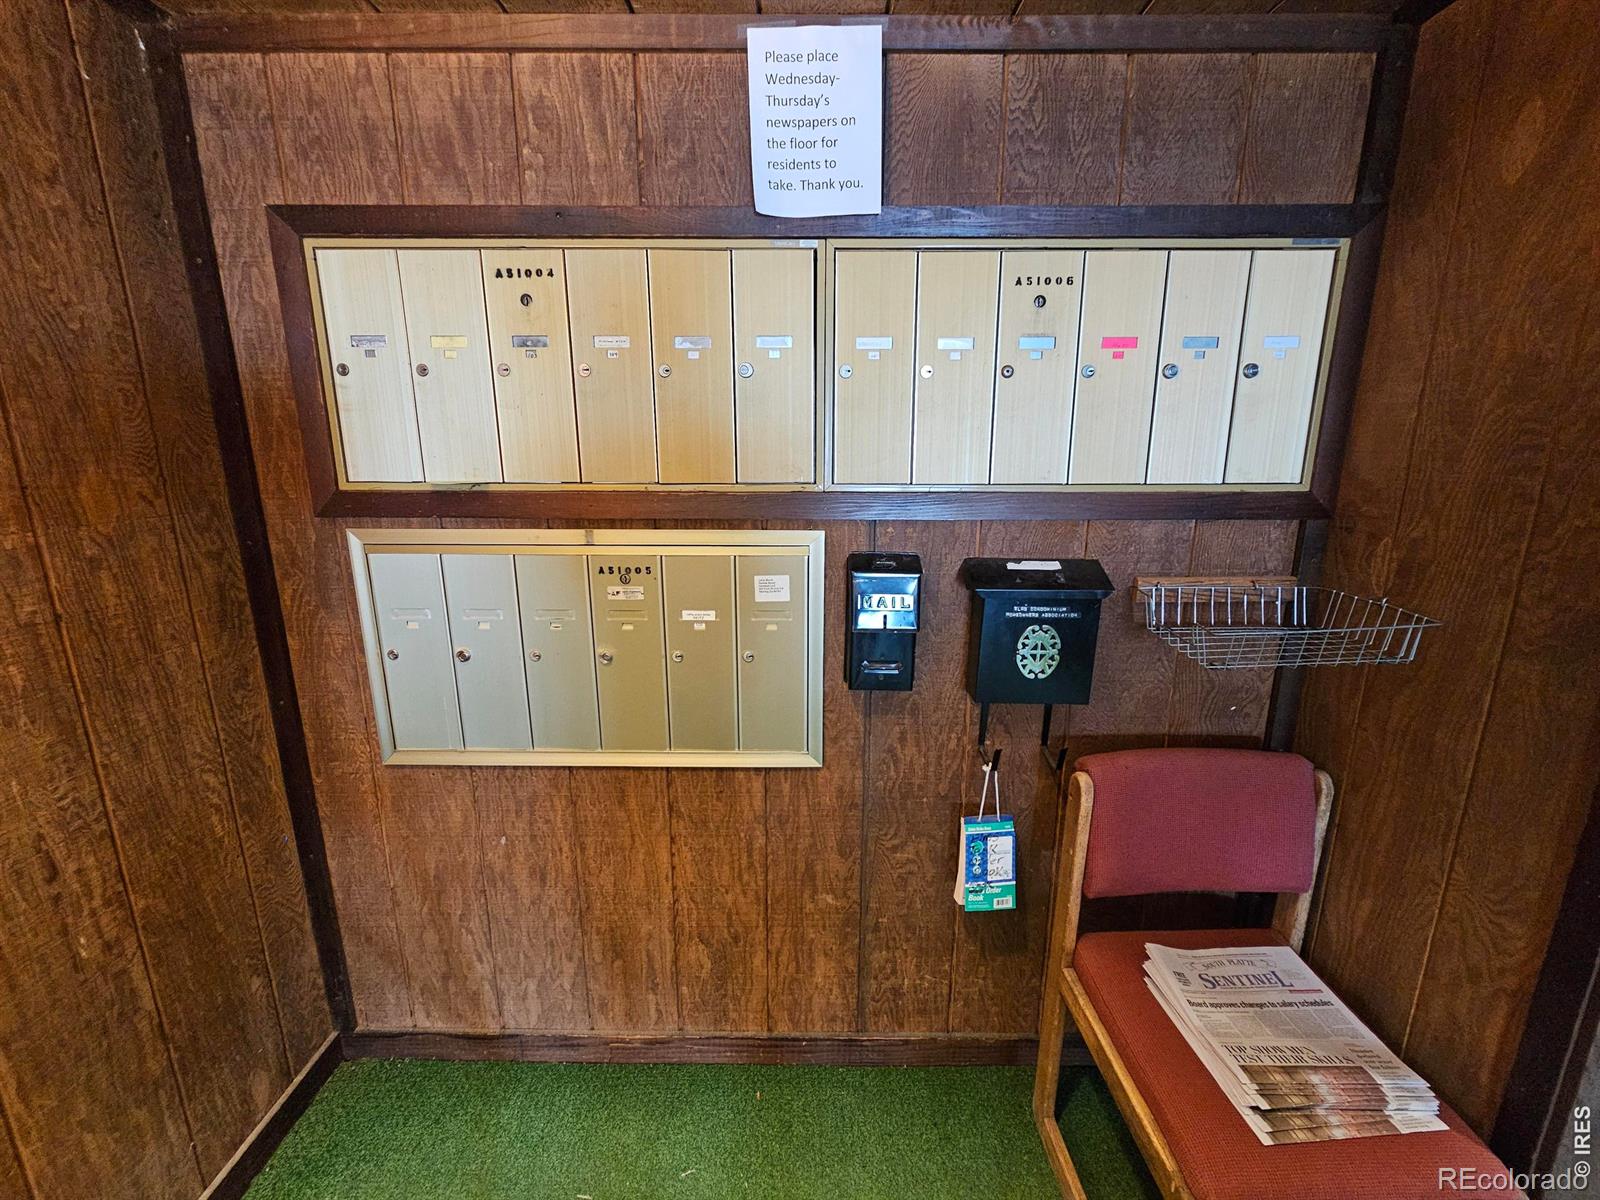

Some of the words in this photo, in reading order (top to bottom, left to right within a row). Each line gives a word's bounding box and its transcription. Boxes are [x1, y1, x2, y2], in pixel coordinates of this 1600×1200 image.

[765, 51, 803, 63] Please
[807, 49, 839, 64] place
[764, 72, 840, 87] Wednesday-
[765, 94, 830, 109] Thursday's
[766, 116, 838, 131] newspapers
[840, 115, 856, 127] on
[767, 138, 786, 149] the
[790, 138, 818, 149] floor
[821, 136, 839, 148] for
[768, 158, 821, 170] residents
[824, 159, 837, 169] to
[768, 180, 797, 191] take.
[800, 178, 835, 191] Thank
[838, 178, 864, 191] you.
[495, 267, 554, 279] A51004
[1015, 276, 1074, 286] A51006
[598, 566, 652, 575] A51005
[858, 594, 911, 610] MAIL
[1187, 999, 1209, 1009] Board
[1209, 1001, 1241, 1010] approves
[1240, 1000, 1270, 1010] changes
[1268, 1000, 1278, 1008] to
[1276, 1000, 1300, 1009] salary
[1298, 999, 1335, 1008] schedules
[1221, 1044, 1248, 1054] TOP
[1263, 1054, 1309, 1065] THEIR
[1307, 1055, 1356, 1065] SKILLS
